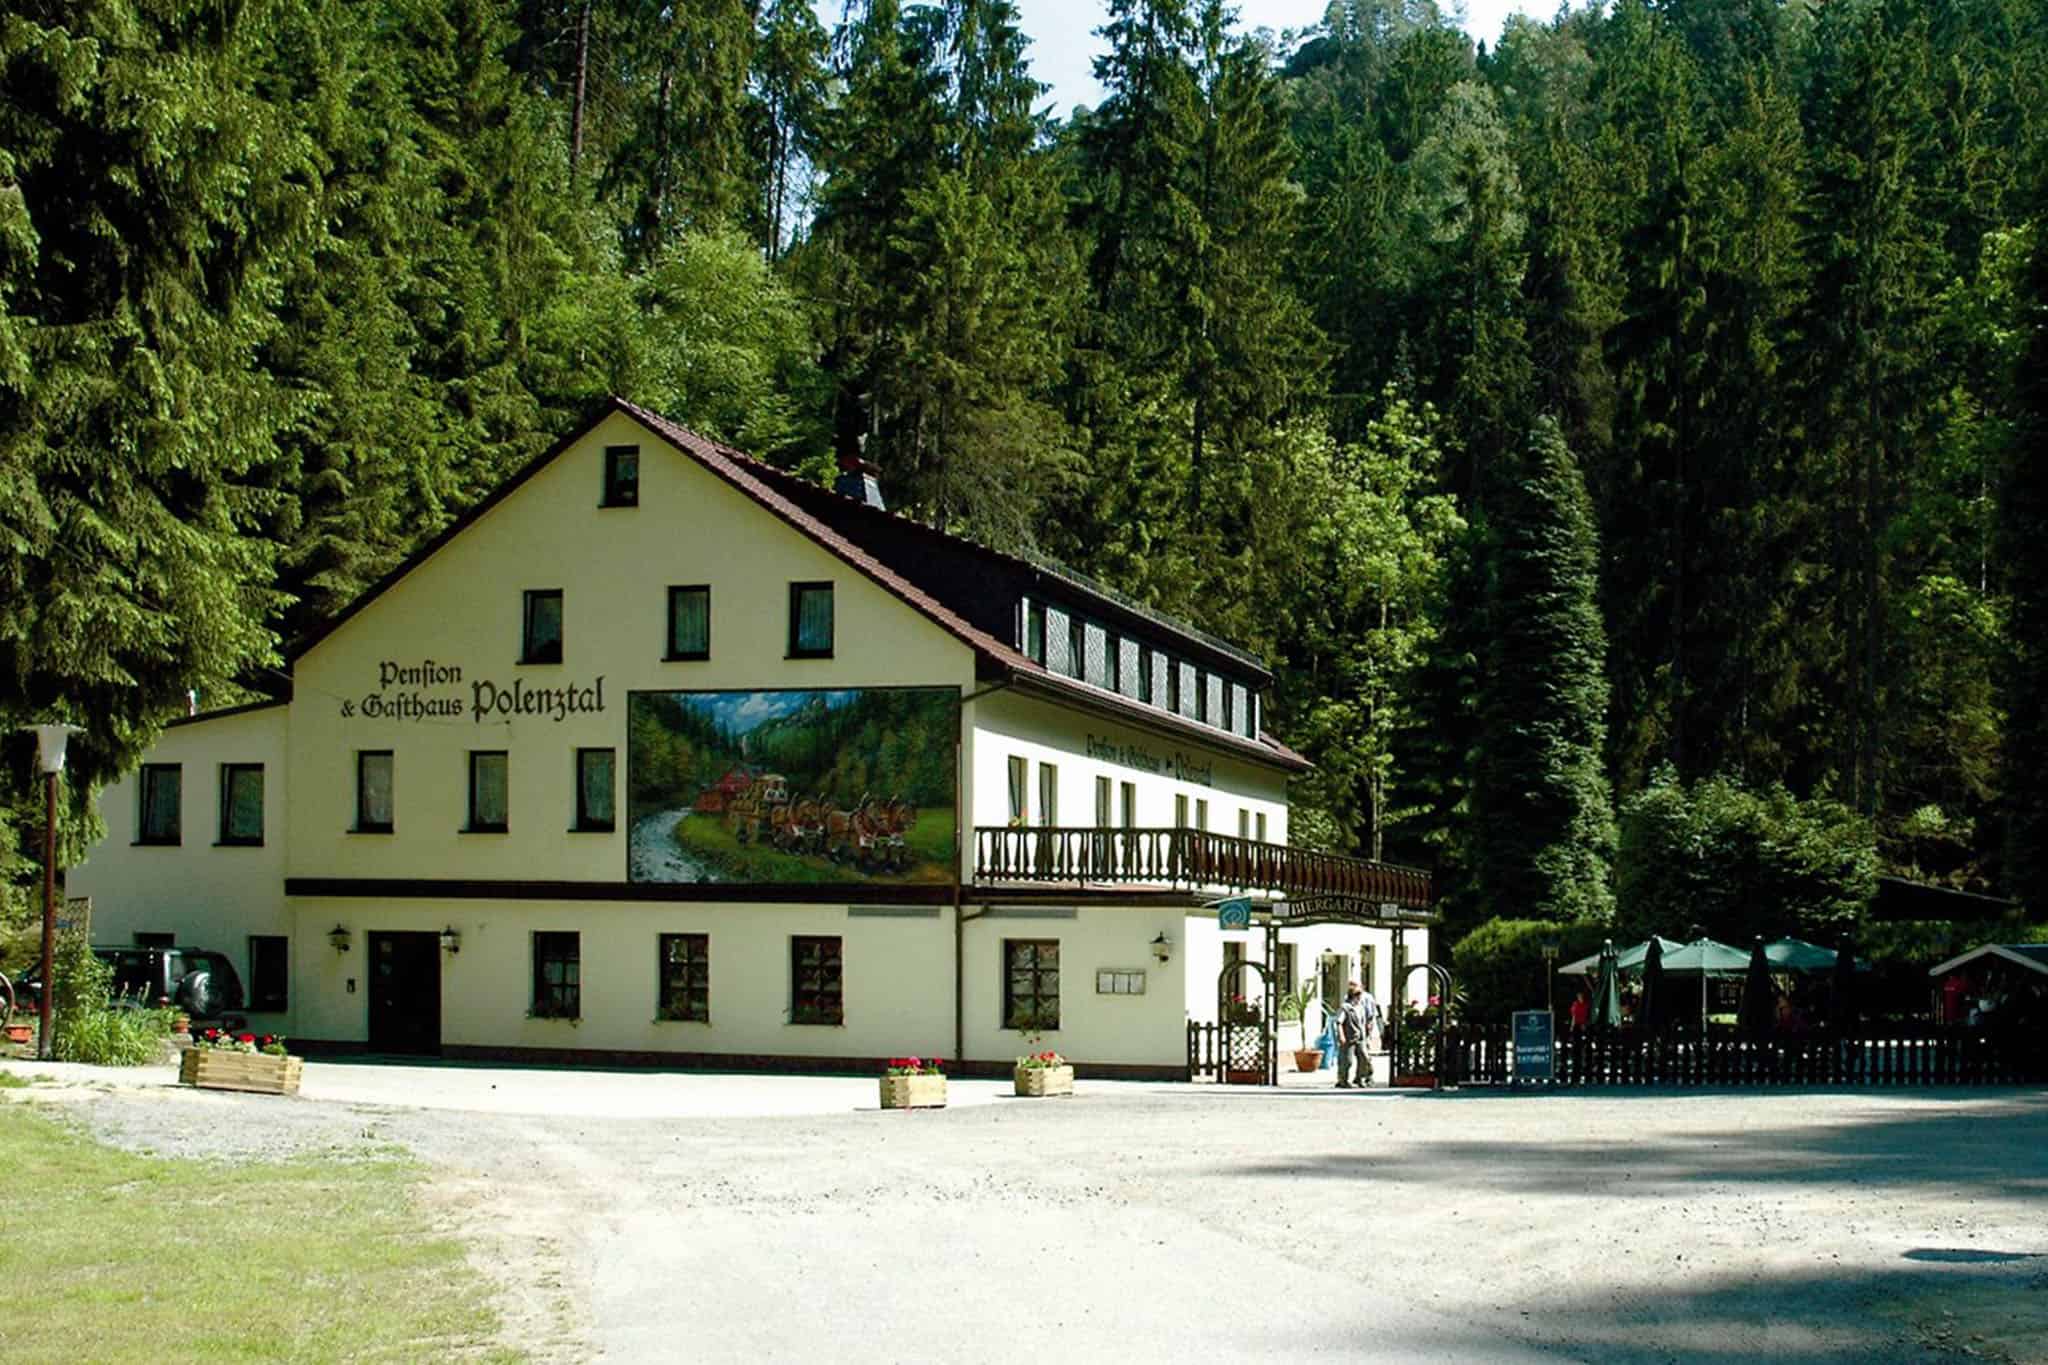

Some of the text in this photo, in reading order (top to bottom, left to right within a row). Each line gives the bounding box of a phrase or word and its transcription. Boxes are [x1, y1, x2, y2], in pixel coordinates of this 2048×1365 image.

[341, 701, 354, 717] &
[471, 676, 605, 723] Polenztal
[1290, 898, 1379, 917] BIERGARTEN
